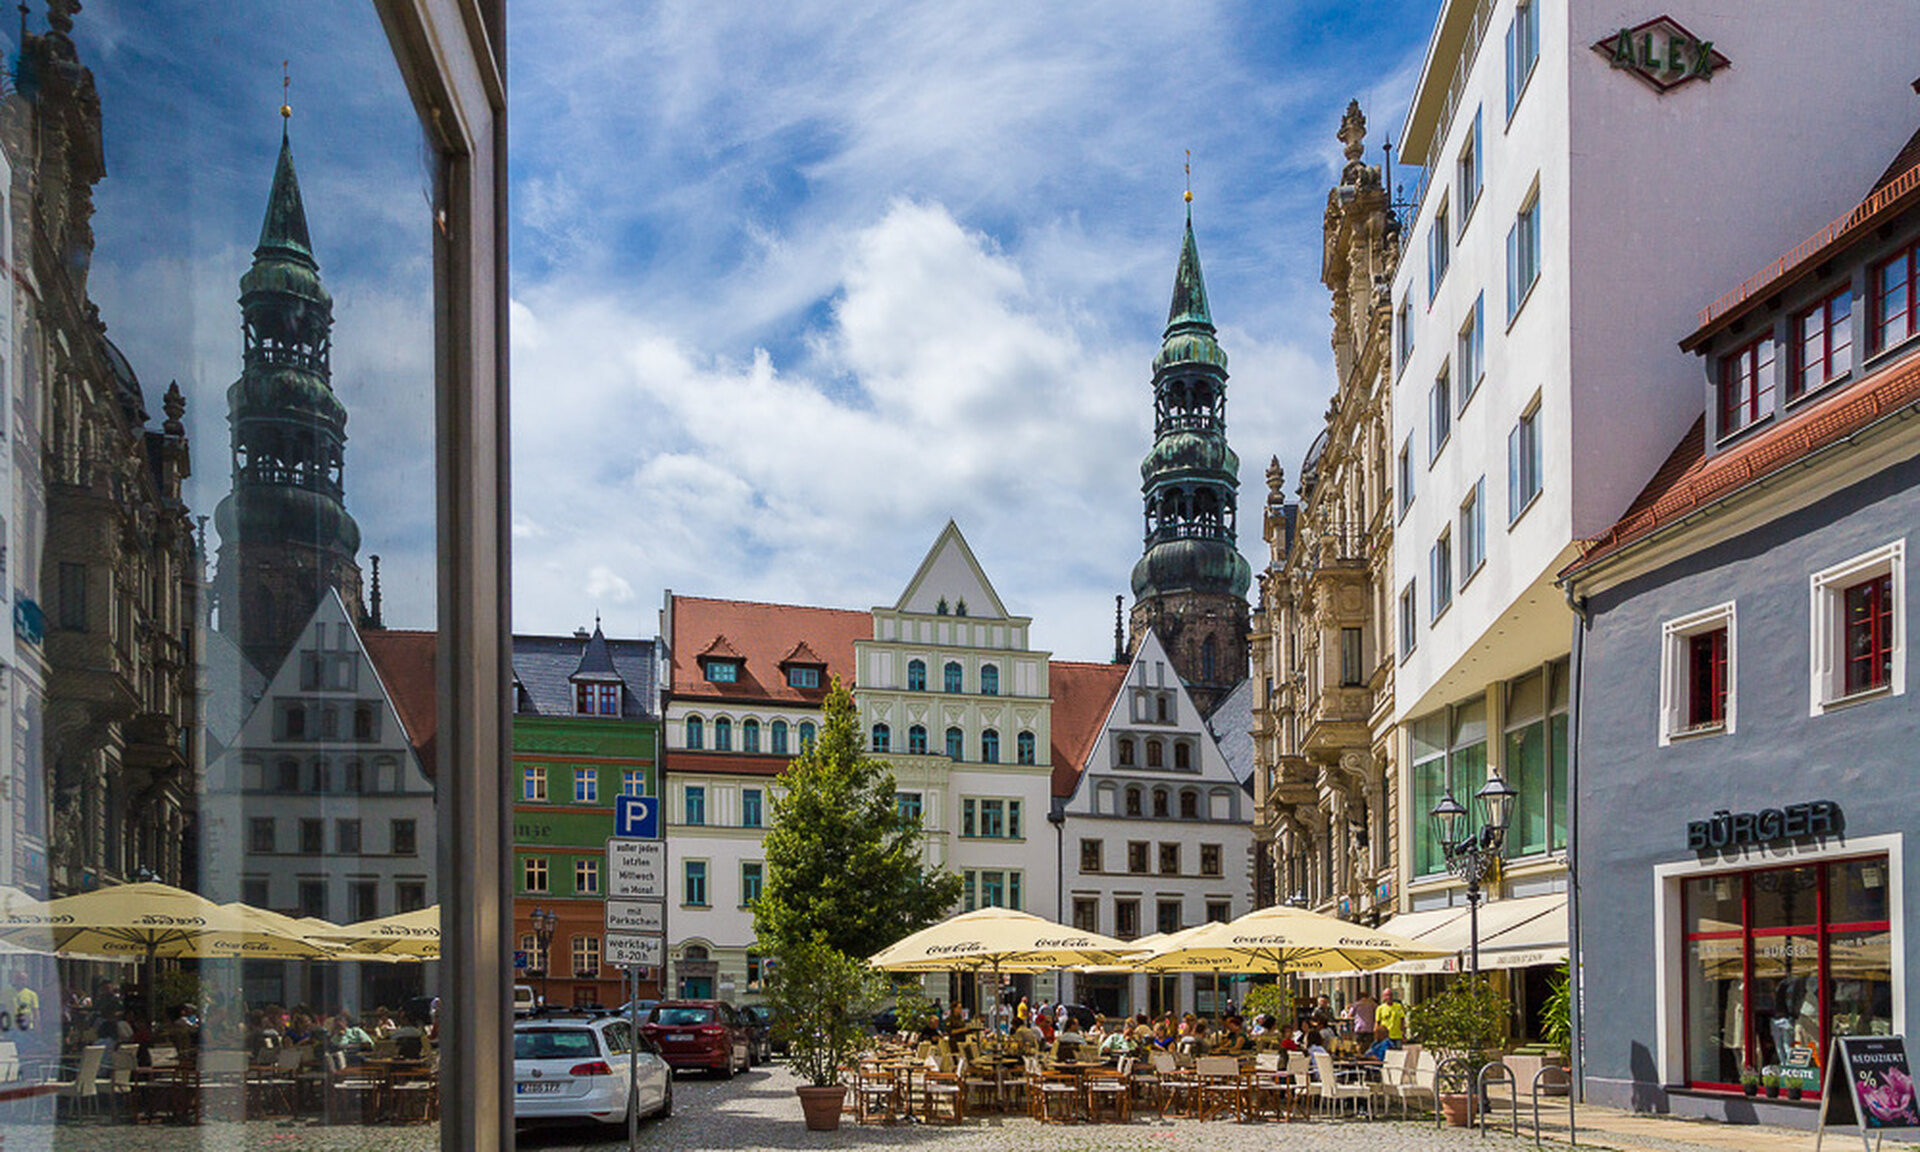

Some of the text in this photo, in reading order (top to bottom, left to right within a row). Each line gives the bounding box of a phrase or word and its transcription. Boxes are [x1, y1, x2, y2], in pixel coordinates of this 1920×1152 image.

[1614, 28, 1713, 77] ALEX
[626, 801, 648, 832] P
[1686, 800, 1844, 851] BÜRGER
[638, 844, 659, 855] jeden
[622, 857, 650, 867] letzten
[619, 871, 655, 881] Mittwoch
[630, 885, 654, 895] Monat
[609, 915, 660, 926] Parkschein
[1851, 1053, 1904, 1064] REDUZIERT
